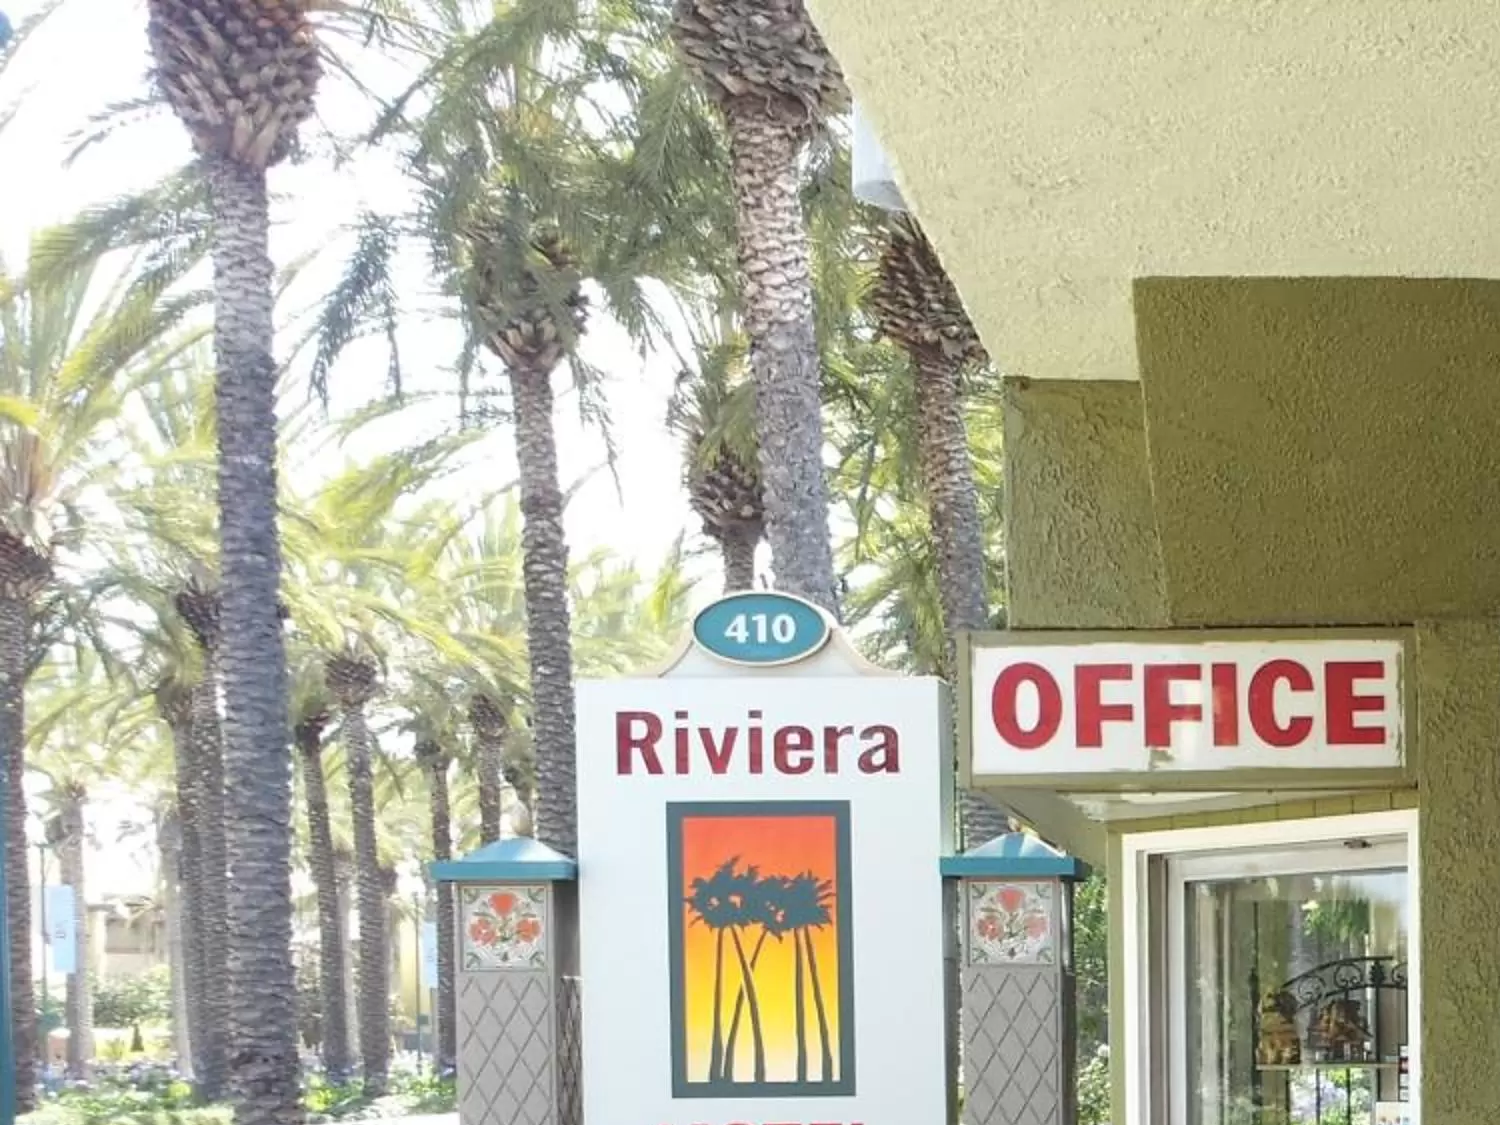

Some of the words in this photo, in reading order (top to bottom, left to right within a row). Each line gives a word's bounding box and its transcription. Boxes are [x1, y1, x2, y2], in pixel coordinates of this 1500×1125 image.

[724, 612, 796, 645] 410
[991, 659, 1386, 749] OFFICE
[615, 710, 900, 776] Riviera
